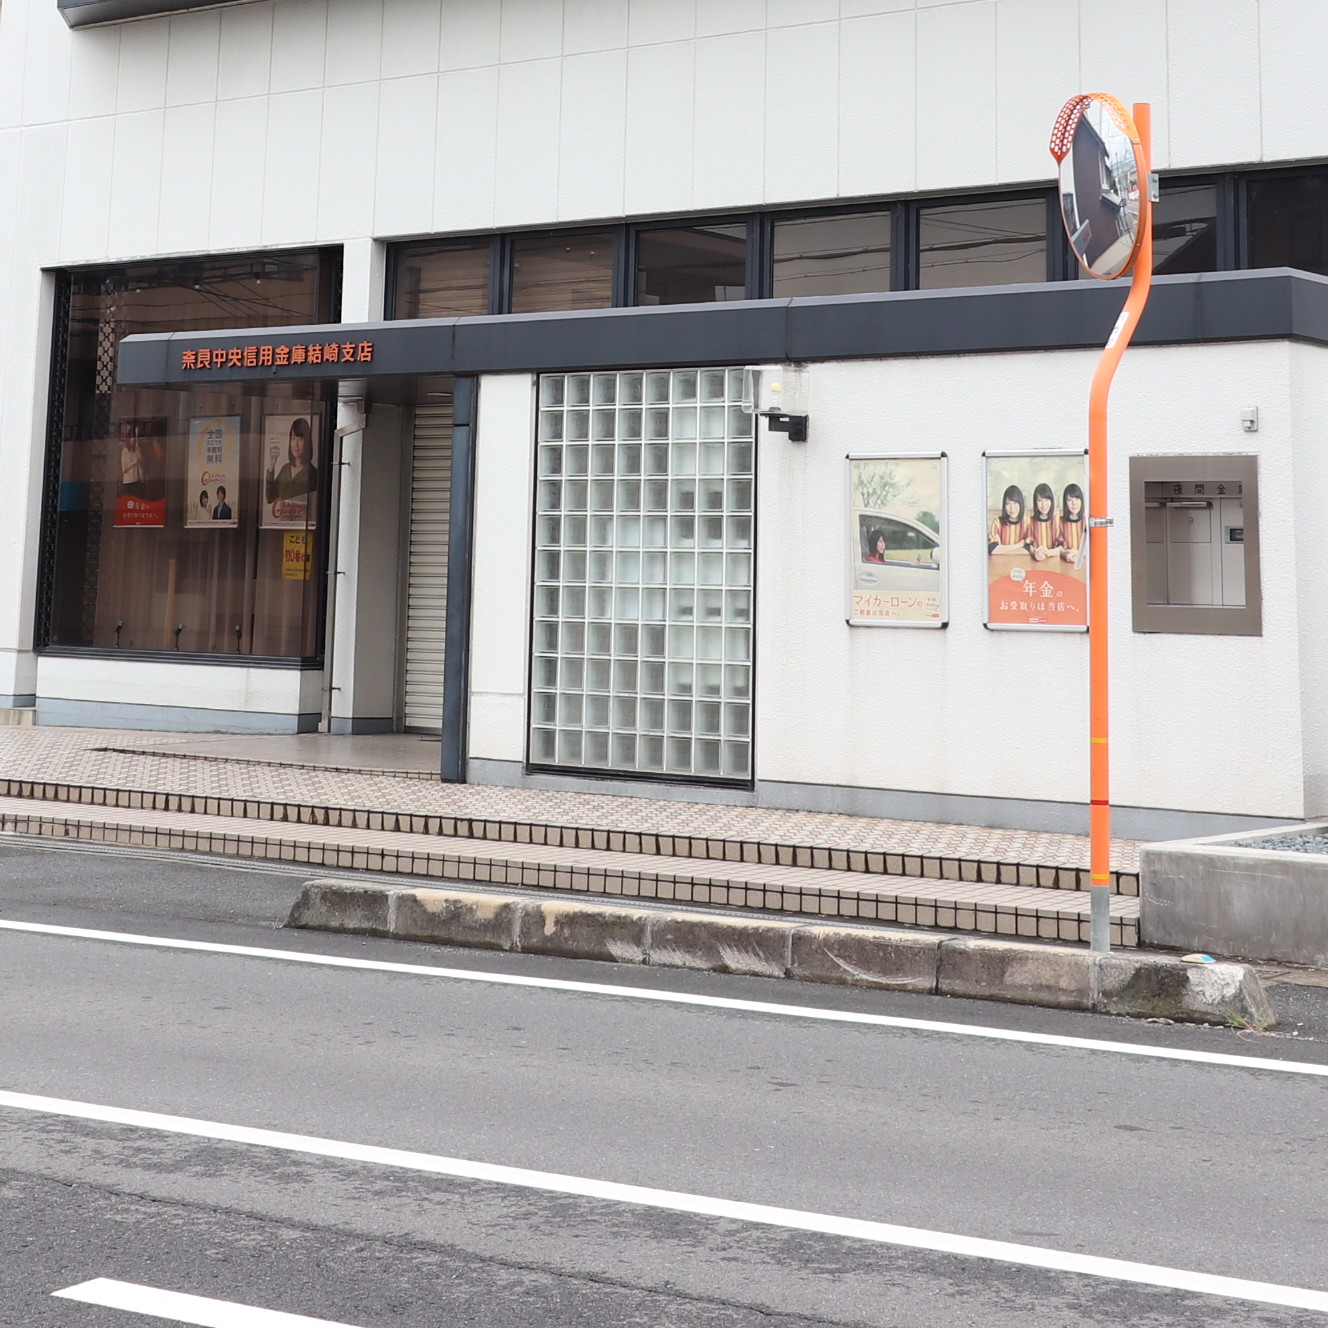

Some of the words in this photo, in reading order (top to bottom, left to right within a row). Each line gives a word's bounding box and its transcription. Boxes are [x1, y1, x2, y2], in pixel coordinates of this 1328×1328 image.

[181, 340, 373, 370] 奈良中央信用金庫結崎支店
[1023, 580, 1063, 598] 年金の
[852, 595, 923, 607] マイカーローンの
